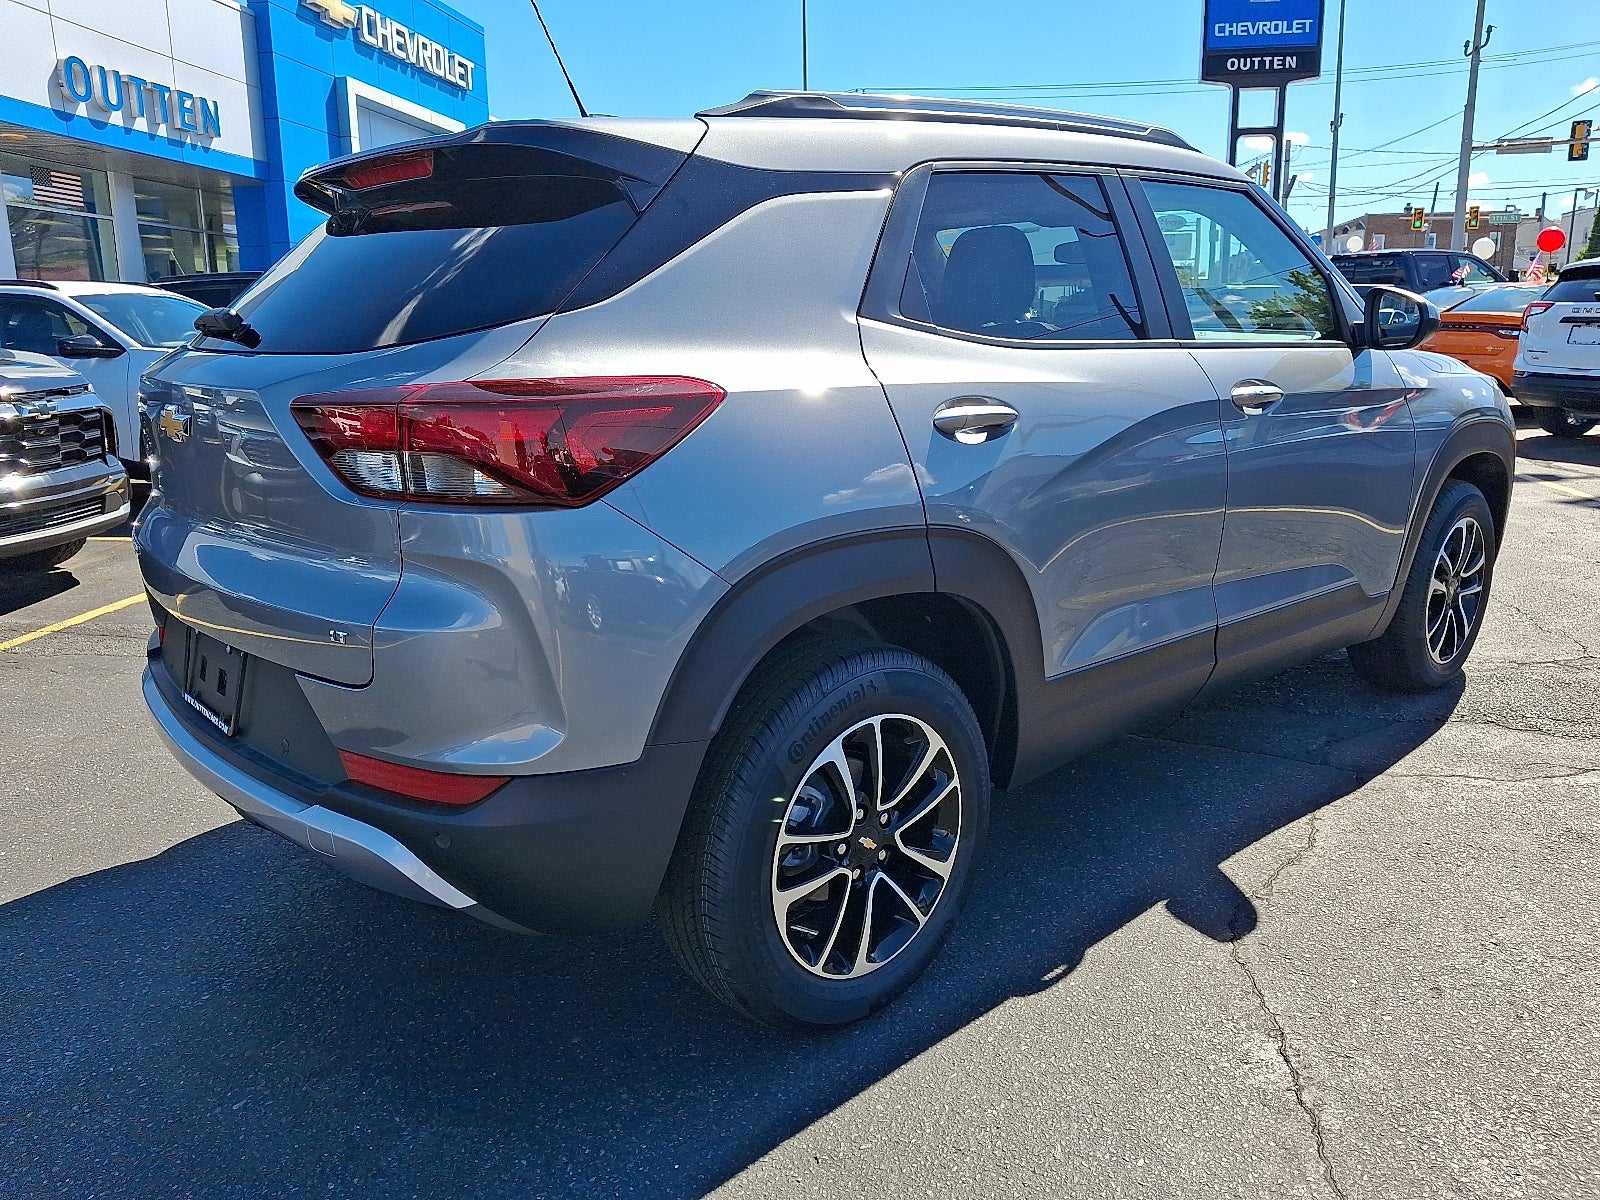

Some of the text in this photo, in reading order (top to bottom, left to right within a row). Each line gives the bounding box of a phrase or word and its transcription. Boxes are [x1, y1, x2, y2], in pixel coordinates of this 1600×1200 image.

[360, 5, 475, 91] CHEVROLET
[1214, 19, 1314, 37] CHEVROLET
[1226, 56, 1297, 71] OUTTEN
[57, 55, 222, 138] OUTTEN
[787, 683, 866, 765] Continental
